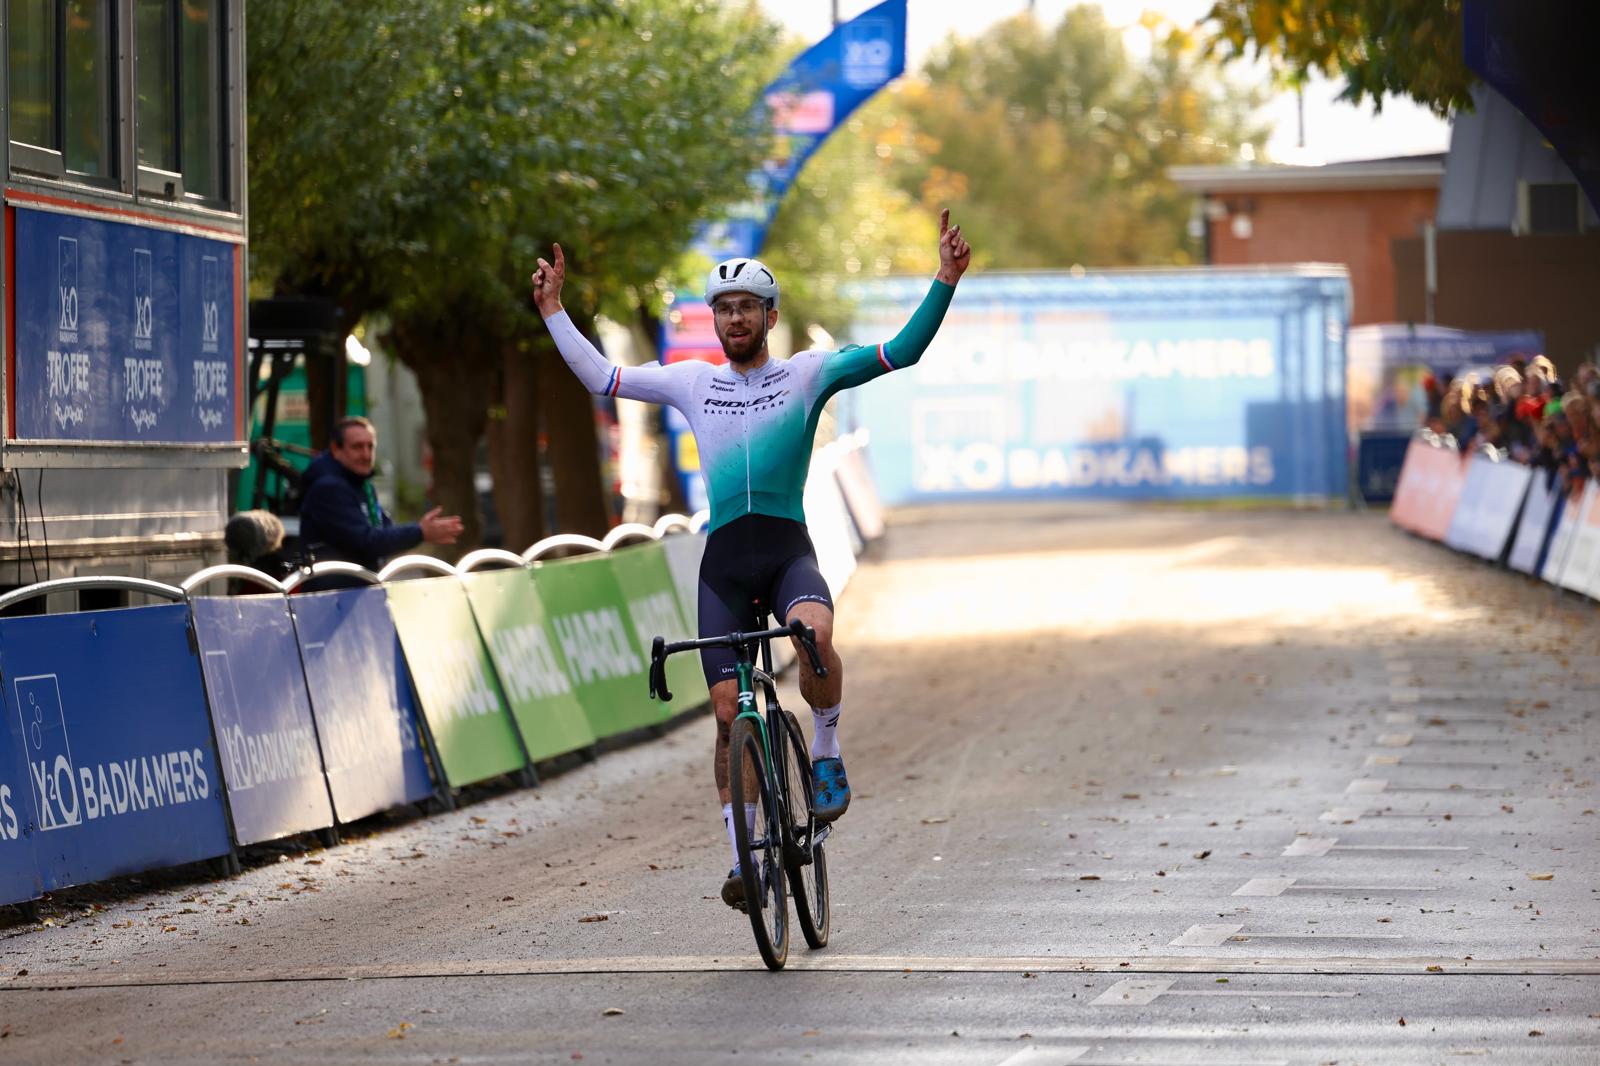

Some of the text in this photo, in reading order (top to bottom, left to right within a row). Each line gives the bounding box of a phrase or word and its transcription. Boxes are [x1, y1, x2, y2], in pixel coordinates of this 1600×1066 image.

[48, 351, 90, 398] TROFEE
[124, 358, 162, 403] TROFEE
[193, 361, 228, 403] TROFEE
[704, 400, 784, 416] RACING TEAM
[1007, 445, 1275, 487] BADKAMERS
[80, 747, 209, 820] BADKAMERS
